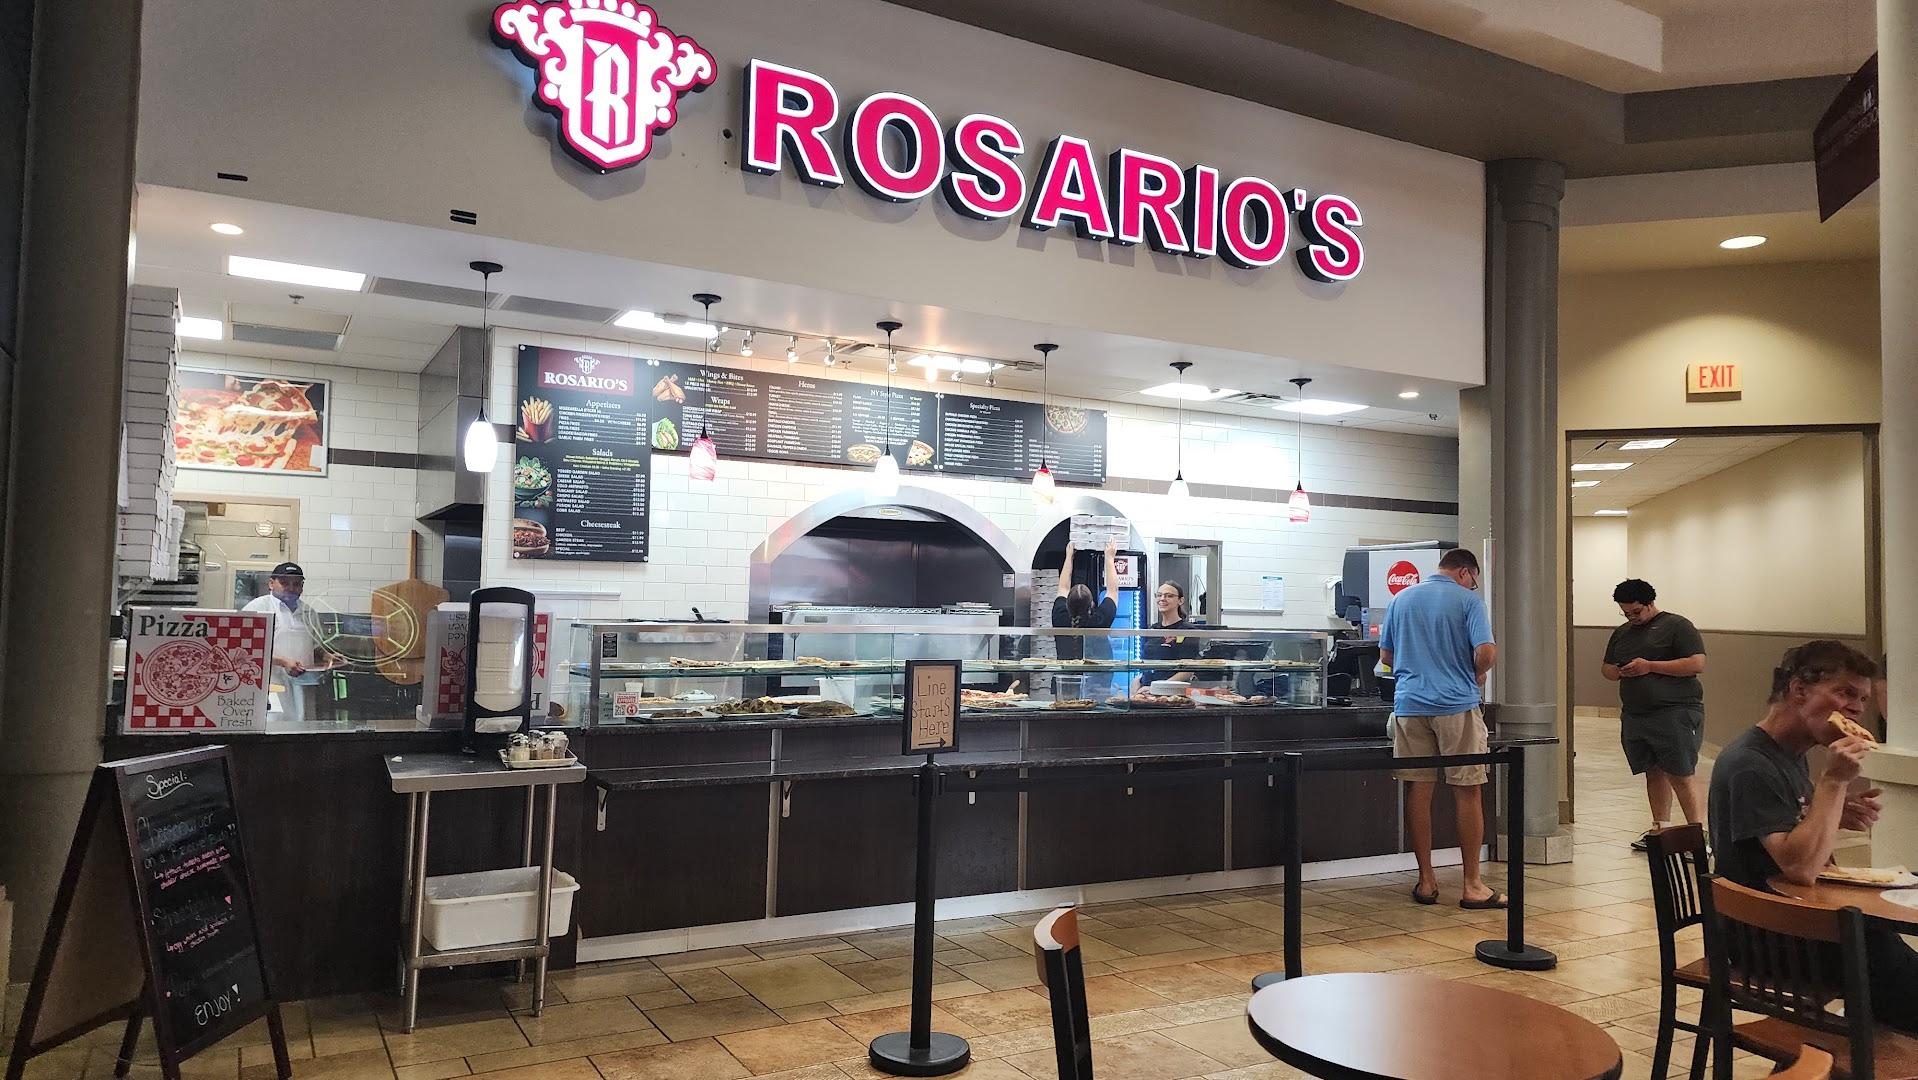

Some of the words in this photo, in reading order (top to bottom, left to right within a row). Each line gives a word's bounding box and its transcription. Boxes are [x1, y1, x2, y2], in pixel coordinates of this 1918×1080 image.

[745, 58, 1365, 282] ROSARIO'S
[544, 371, 628, 392] ROSARIO'S
[700, 369, 720, 380] Wings
[729, 373, 744, 382] Bites
[1699, 365, 1736, 389] EXIT
[711, 396, 731, 405] Wraps
[892, 392, 904, 400] Pizza
[585, 400, 621, 409] Appetizers
[970, 402, 988, 411] Specialty
[592, 448, 613, 457] Salads
[580, 520, 622, 529] Cheesesteak
[138, 614, 209, 638] Pizza
[917, 675, 947, 697] Line
[218, 692, 255, 707] Baked
[222, 705, 254, 718] Oven
[220, 716, 252, 728] Fresh
[919, 720, 950, 739] Here
